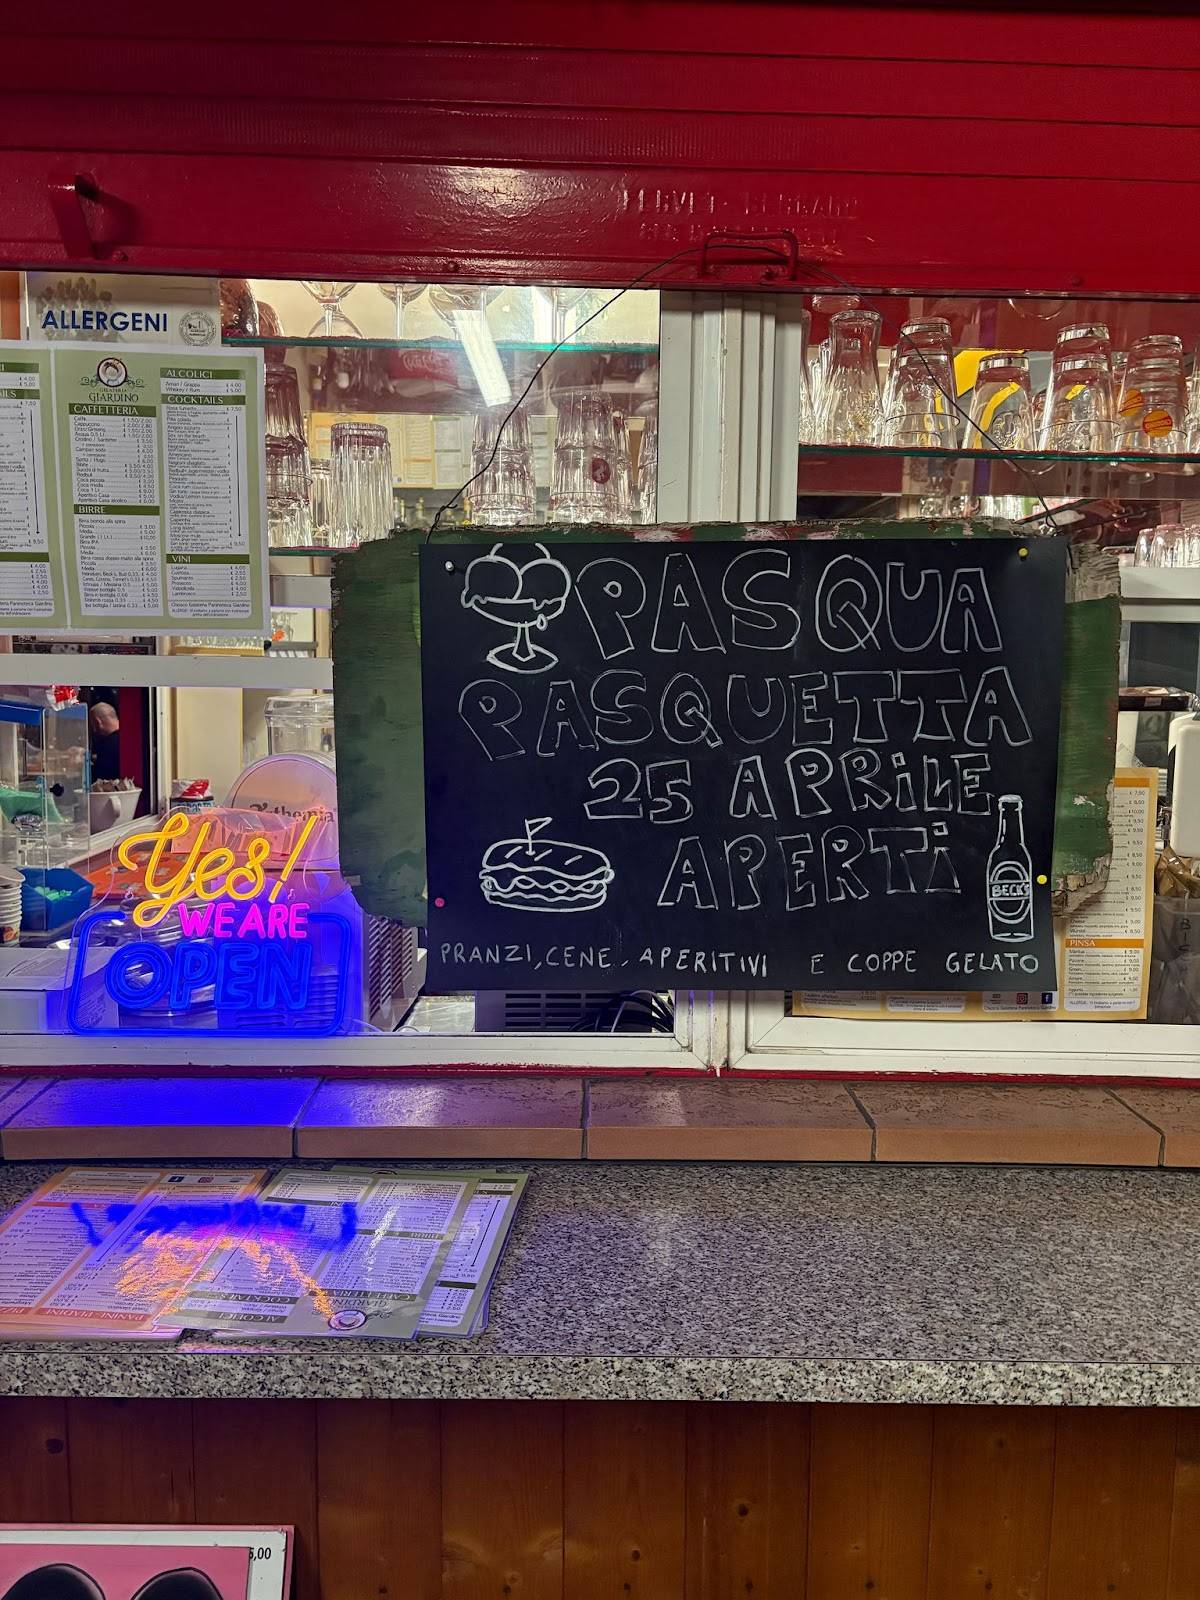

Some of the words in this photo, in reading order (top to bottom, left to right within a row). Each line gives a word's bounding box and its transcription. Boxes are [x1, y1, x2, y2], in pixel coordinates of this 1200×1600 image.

[42, 310, 168, 332] ALLERGENI
[166, 369, 213, 378] ALCOLICI
[74, 404, 138, 415] CAFFETTERIA
[167, 396, 224, 404] COCKTAILS
[78, 506, 106, 514] BIRRE
[575, 548, 1003, 660] PASQUA
[458, 666, 1033, 761] PASQUETTA
[584, 758, 694, 824] 25
[117, 812, 320, 928] Yes!
[177, 902, 235, 938] WE
[237, 902, 310, 938] ARE
[105, 942, 313, 1010] OPEN
[639, 947, 767, 977] APERITIVI
[810, 954, 825, 974] E
[847, 951, 917, 973] COPPE
[946, 952, 1039, 974] GELATO
